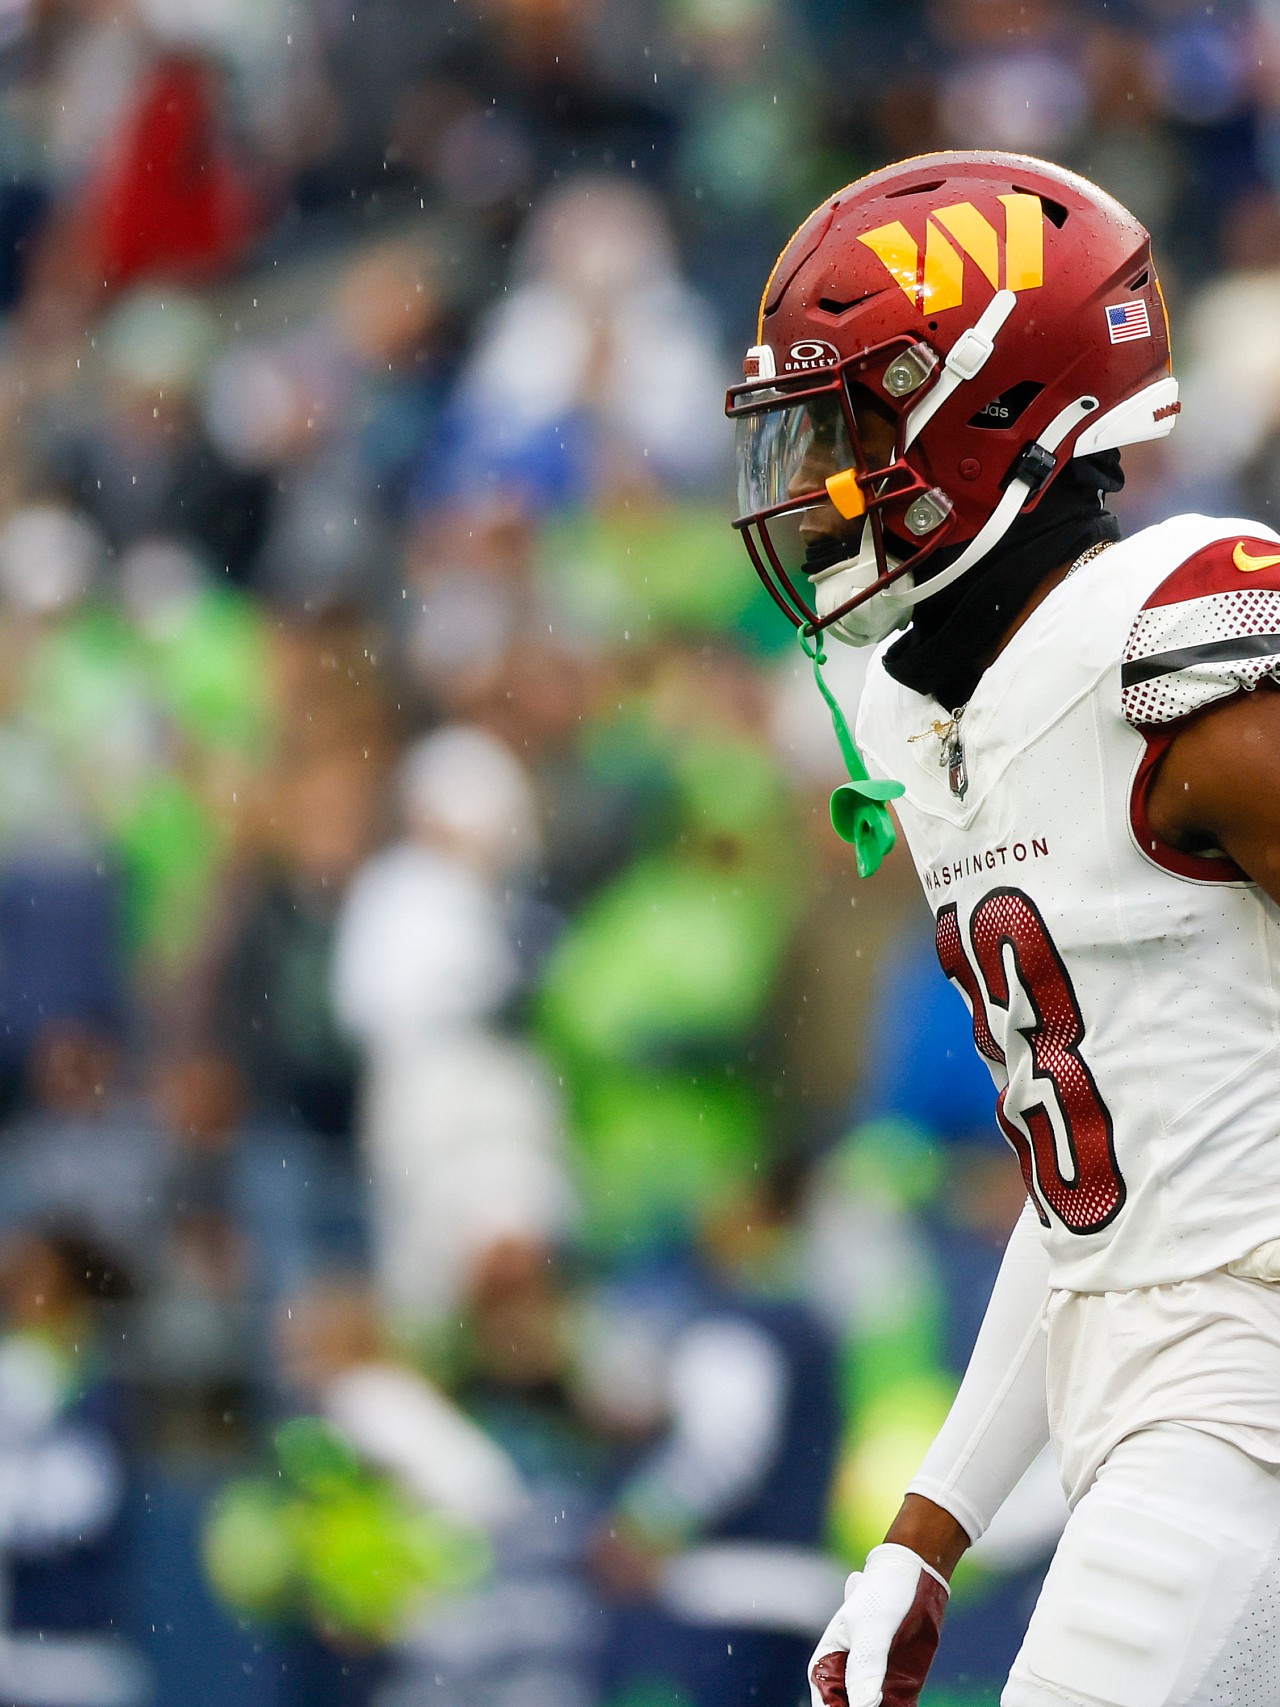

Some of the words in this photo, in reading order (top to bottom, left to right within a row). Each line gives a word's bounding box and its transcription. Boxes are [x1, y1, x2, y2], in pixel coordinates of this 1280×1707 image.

[784, 359, 835, 371] OAKLEY
[923, 838, 1049, 890] WASHINGTON
[936, 886, 1127, 1236] 13
